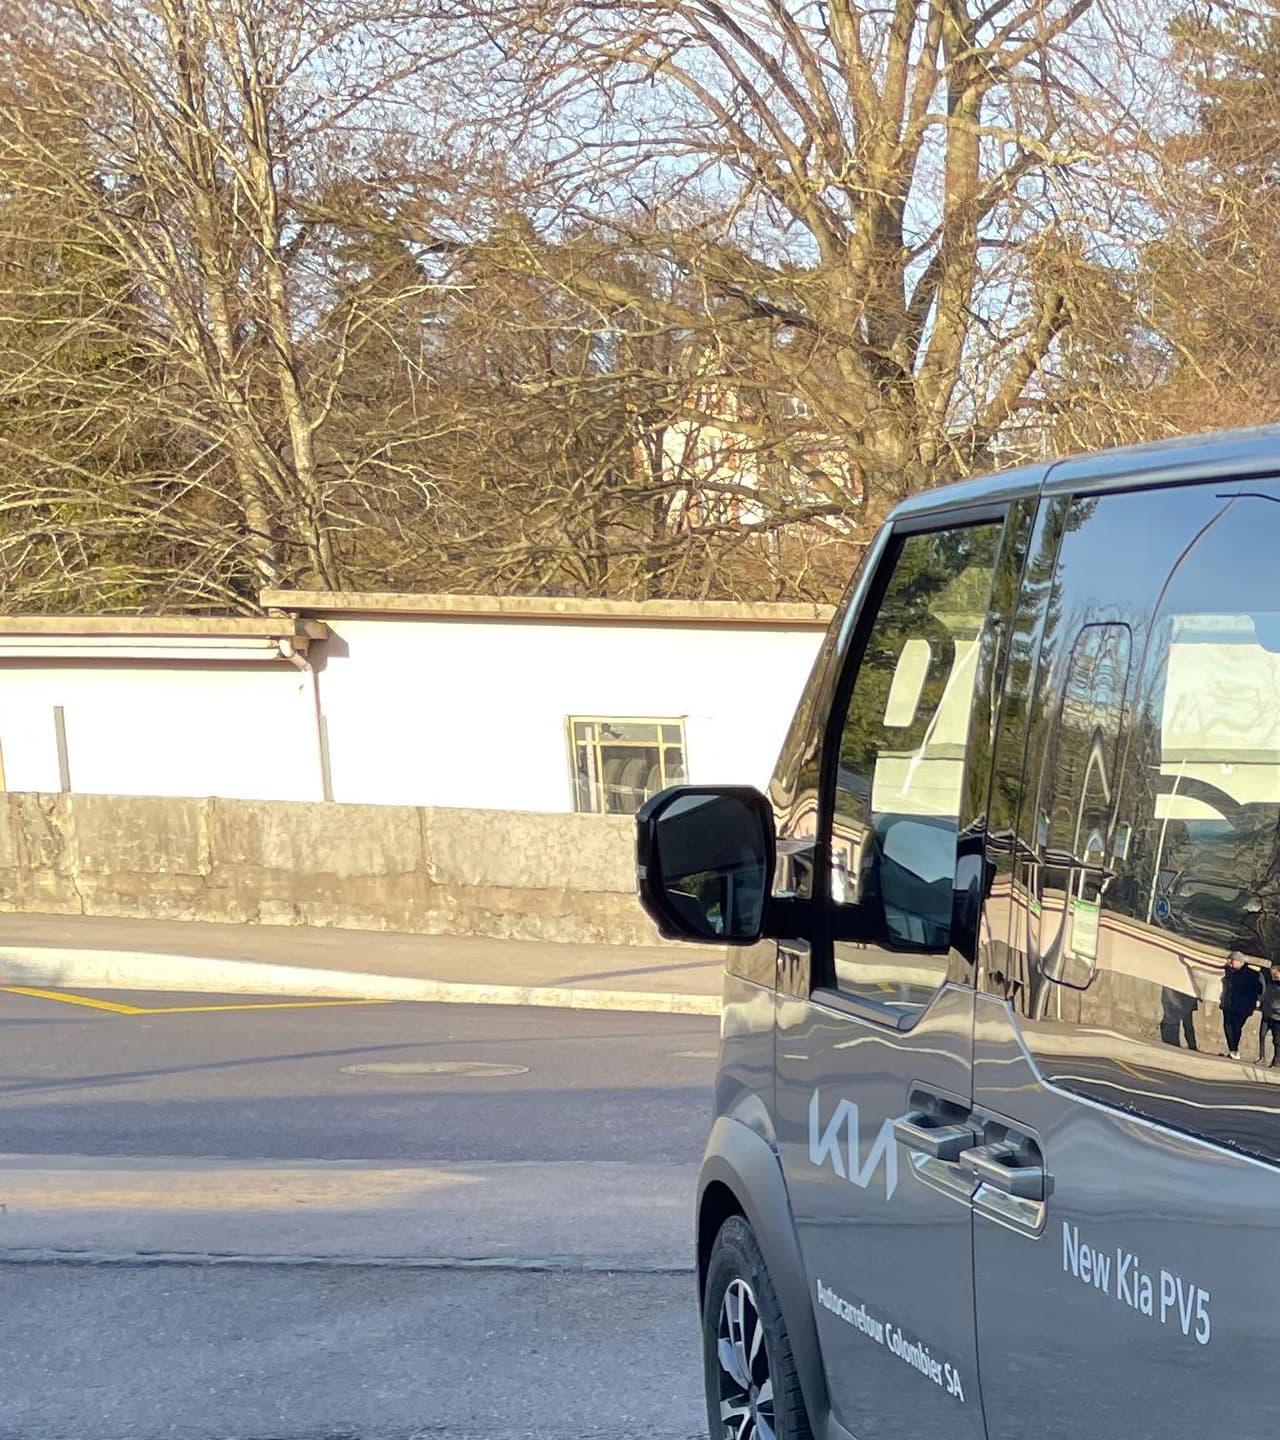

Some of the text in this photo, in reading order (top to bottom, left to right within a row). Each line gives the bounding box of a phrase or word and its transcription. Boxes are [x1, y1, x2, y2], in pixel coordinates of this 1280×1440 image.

[809, 1088, 897, 1200] KIA
[816, 1278, 965, 1402] Autocarrefour Colombier SA
[1062, 1221, 1211, 1345] New Kia PV5
